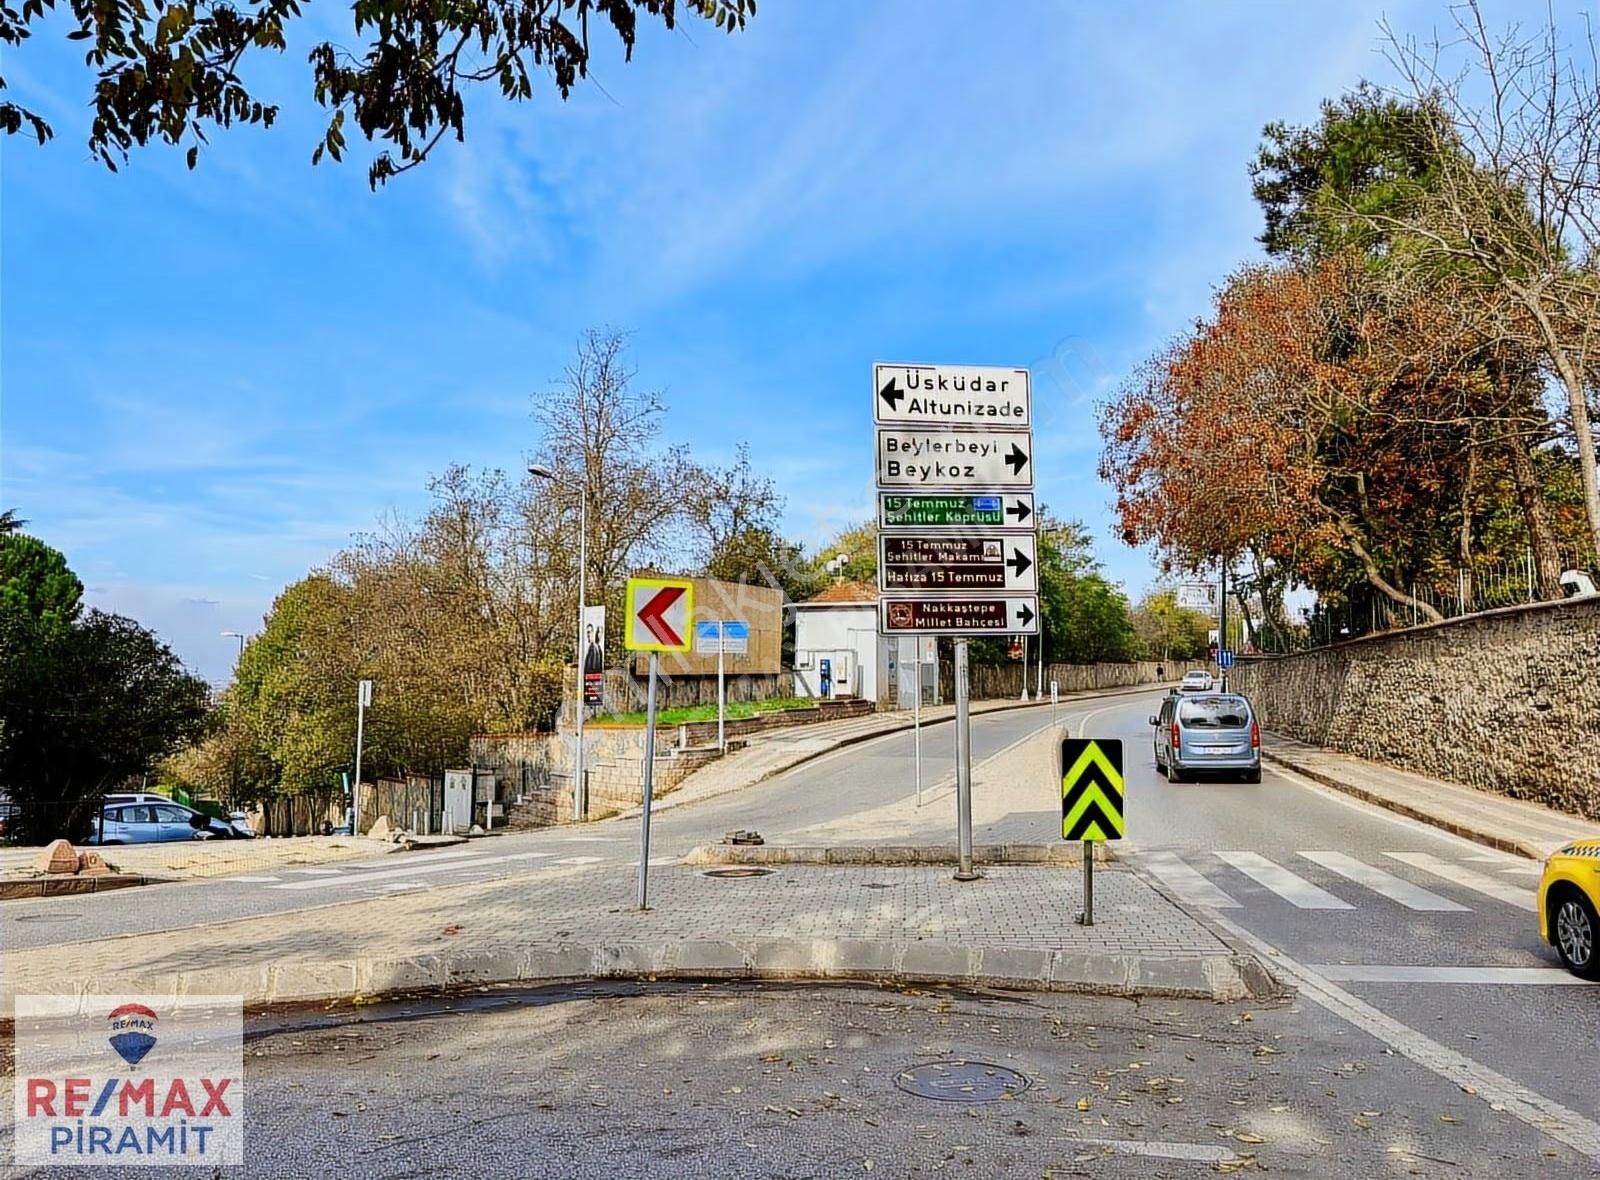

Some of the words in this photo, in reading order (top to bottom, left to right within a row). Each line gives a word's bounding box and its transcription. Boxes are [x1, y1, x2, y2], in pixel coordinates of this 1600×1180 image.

[906, 369, 1009, 392] Üsküdar
[908, 398, 1025, 417] Altunizade
[886, 437, 998, 457] Beylerbeyi
[887, 460, 975, 481] Beykoz
[887, 498, 902, 508] 15
[907, 498, 966, 508] Temmuz
[901, 540, 914, 550] 15
[917, 540, 967, 550] Temmuz
[932, 572, 945, 582] 15
[948, 572, 1003, 582] Temmuz
[915, 617, 951, 627] Millet
[956, 617, 1005, 628] Bahçesi
